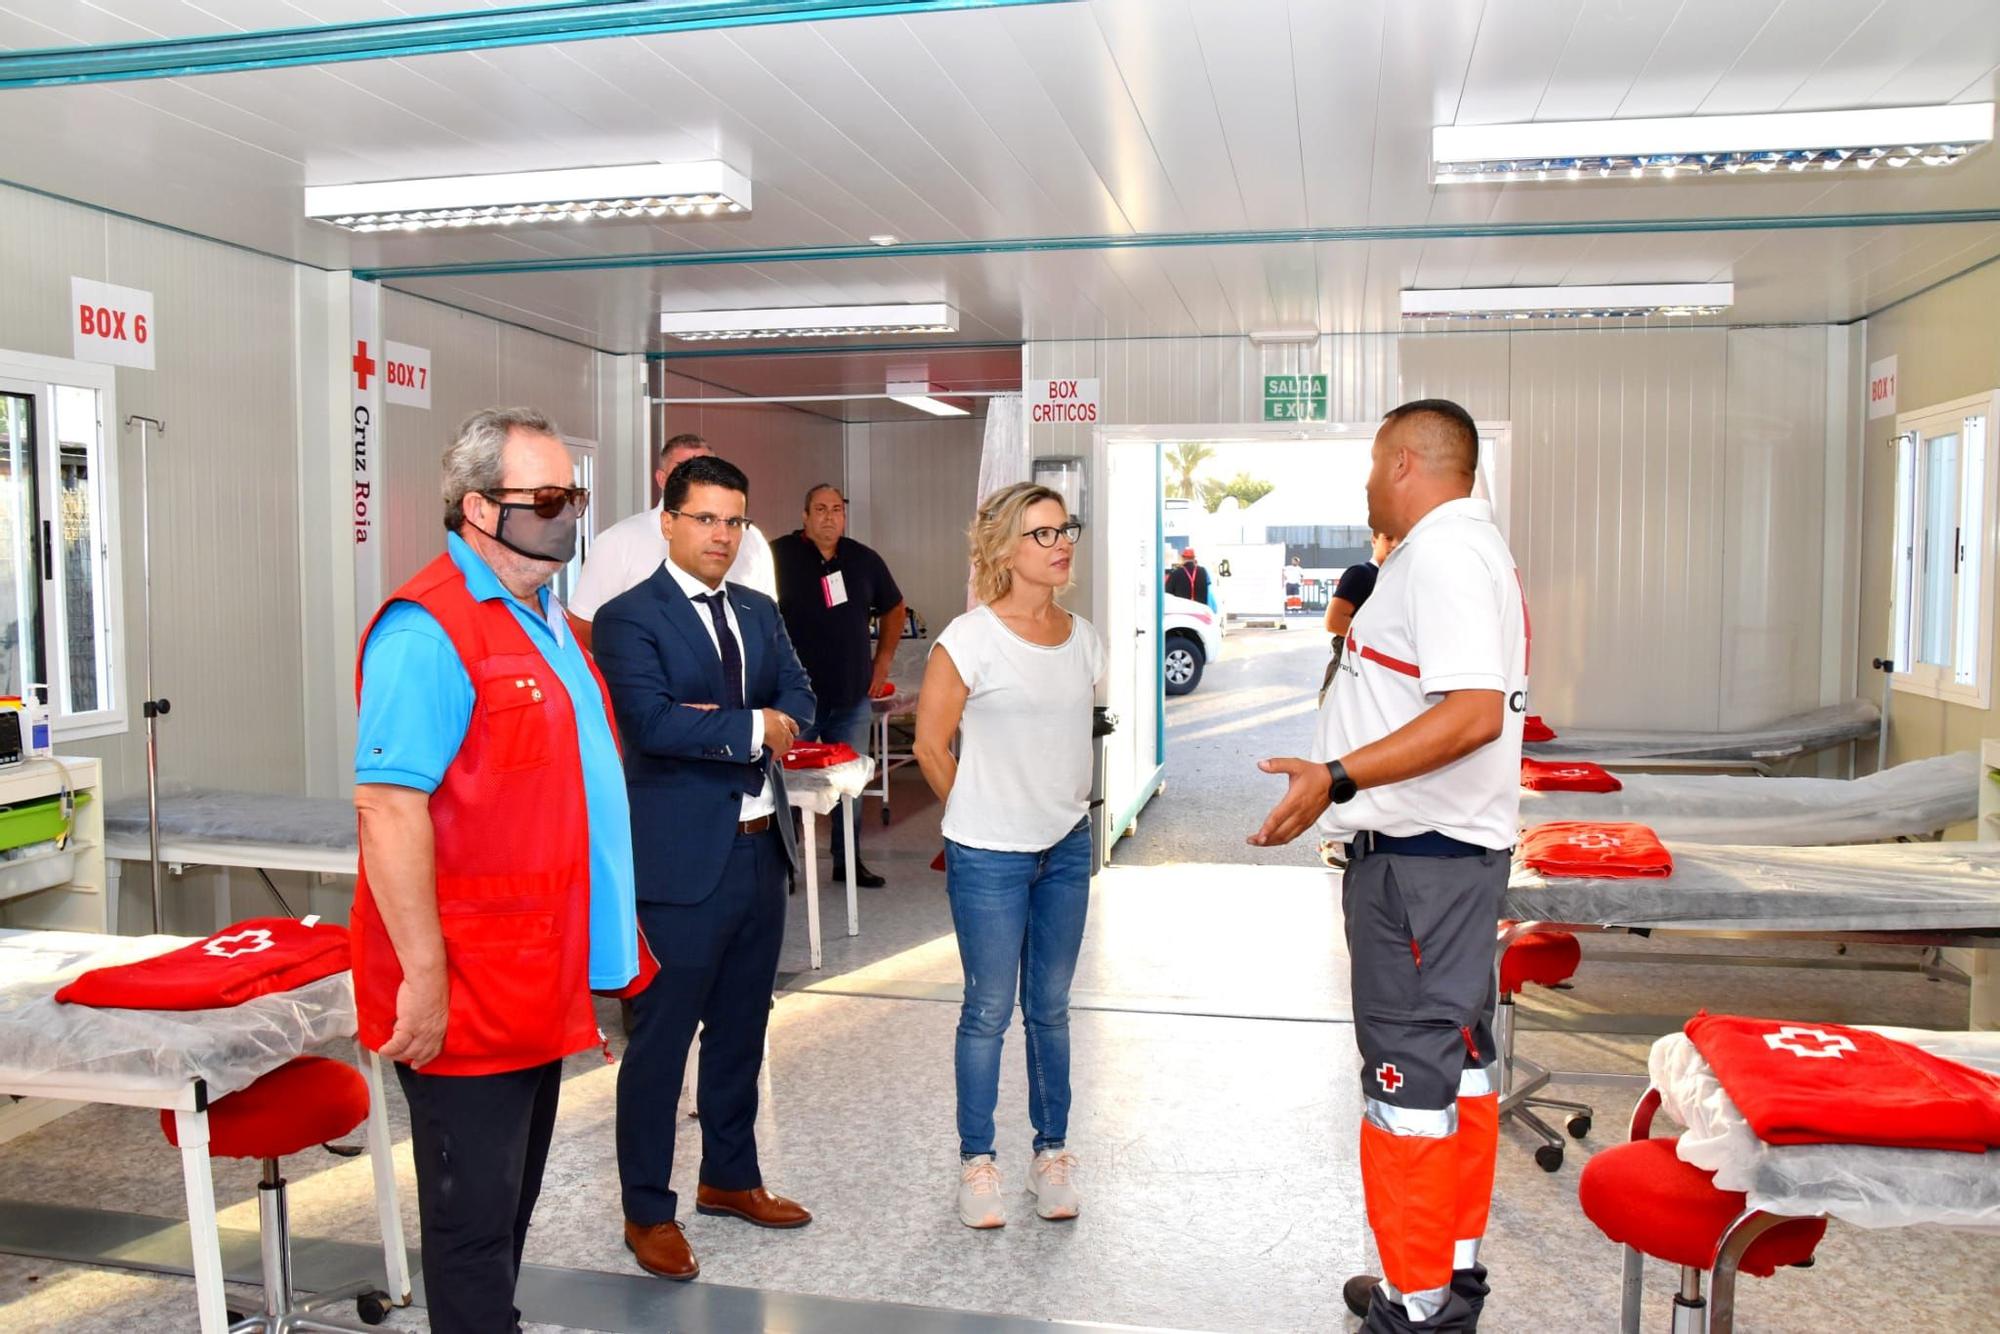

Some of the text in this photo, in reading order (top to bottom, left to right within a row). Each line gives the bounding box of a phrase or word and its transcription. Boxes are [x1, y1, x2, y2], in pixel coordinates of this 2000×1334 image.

[80, 304, 147, 344] BOX 6
[387, 361, 427, 390] BOX 7
[1268, 380, 1322, 394] SALIDA
[1871, 374, 1895, 402] BOX 1
[1049, 380, 1078, 399] BOX
[1033, 399, 1096, 422] CRÍTICOS
[1273, 403, 1318, 417] EXIT
[354, 405, 370, 472] Cruz
